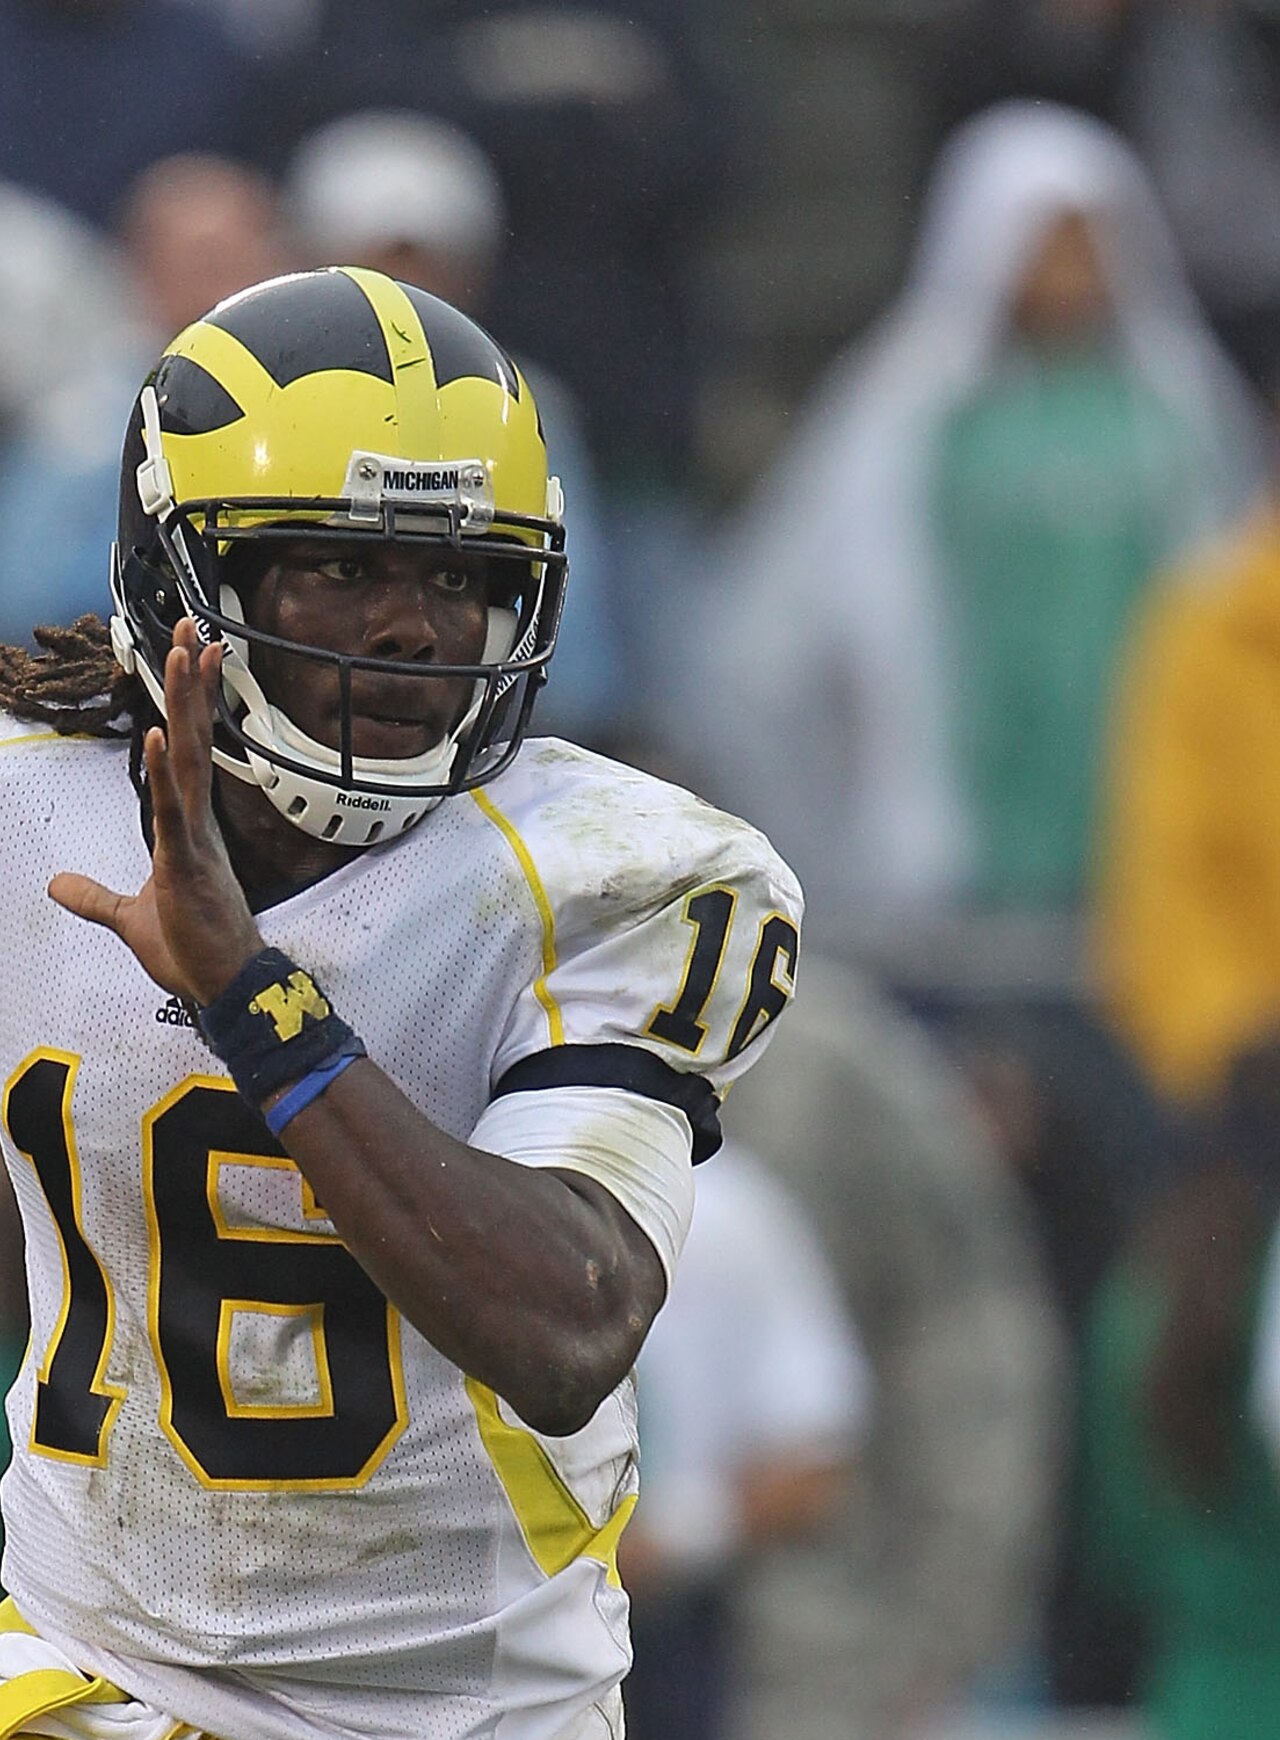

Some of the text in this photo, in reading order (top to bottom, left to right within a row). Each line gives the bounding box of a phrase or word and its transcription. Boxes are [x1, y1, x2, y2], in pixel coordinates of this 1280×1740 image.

[383, 470, 459, 491] MICHIGAN
[642, 883, 800, 1062] 16
[2, 1045, 410, 1492] 16
